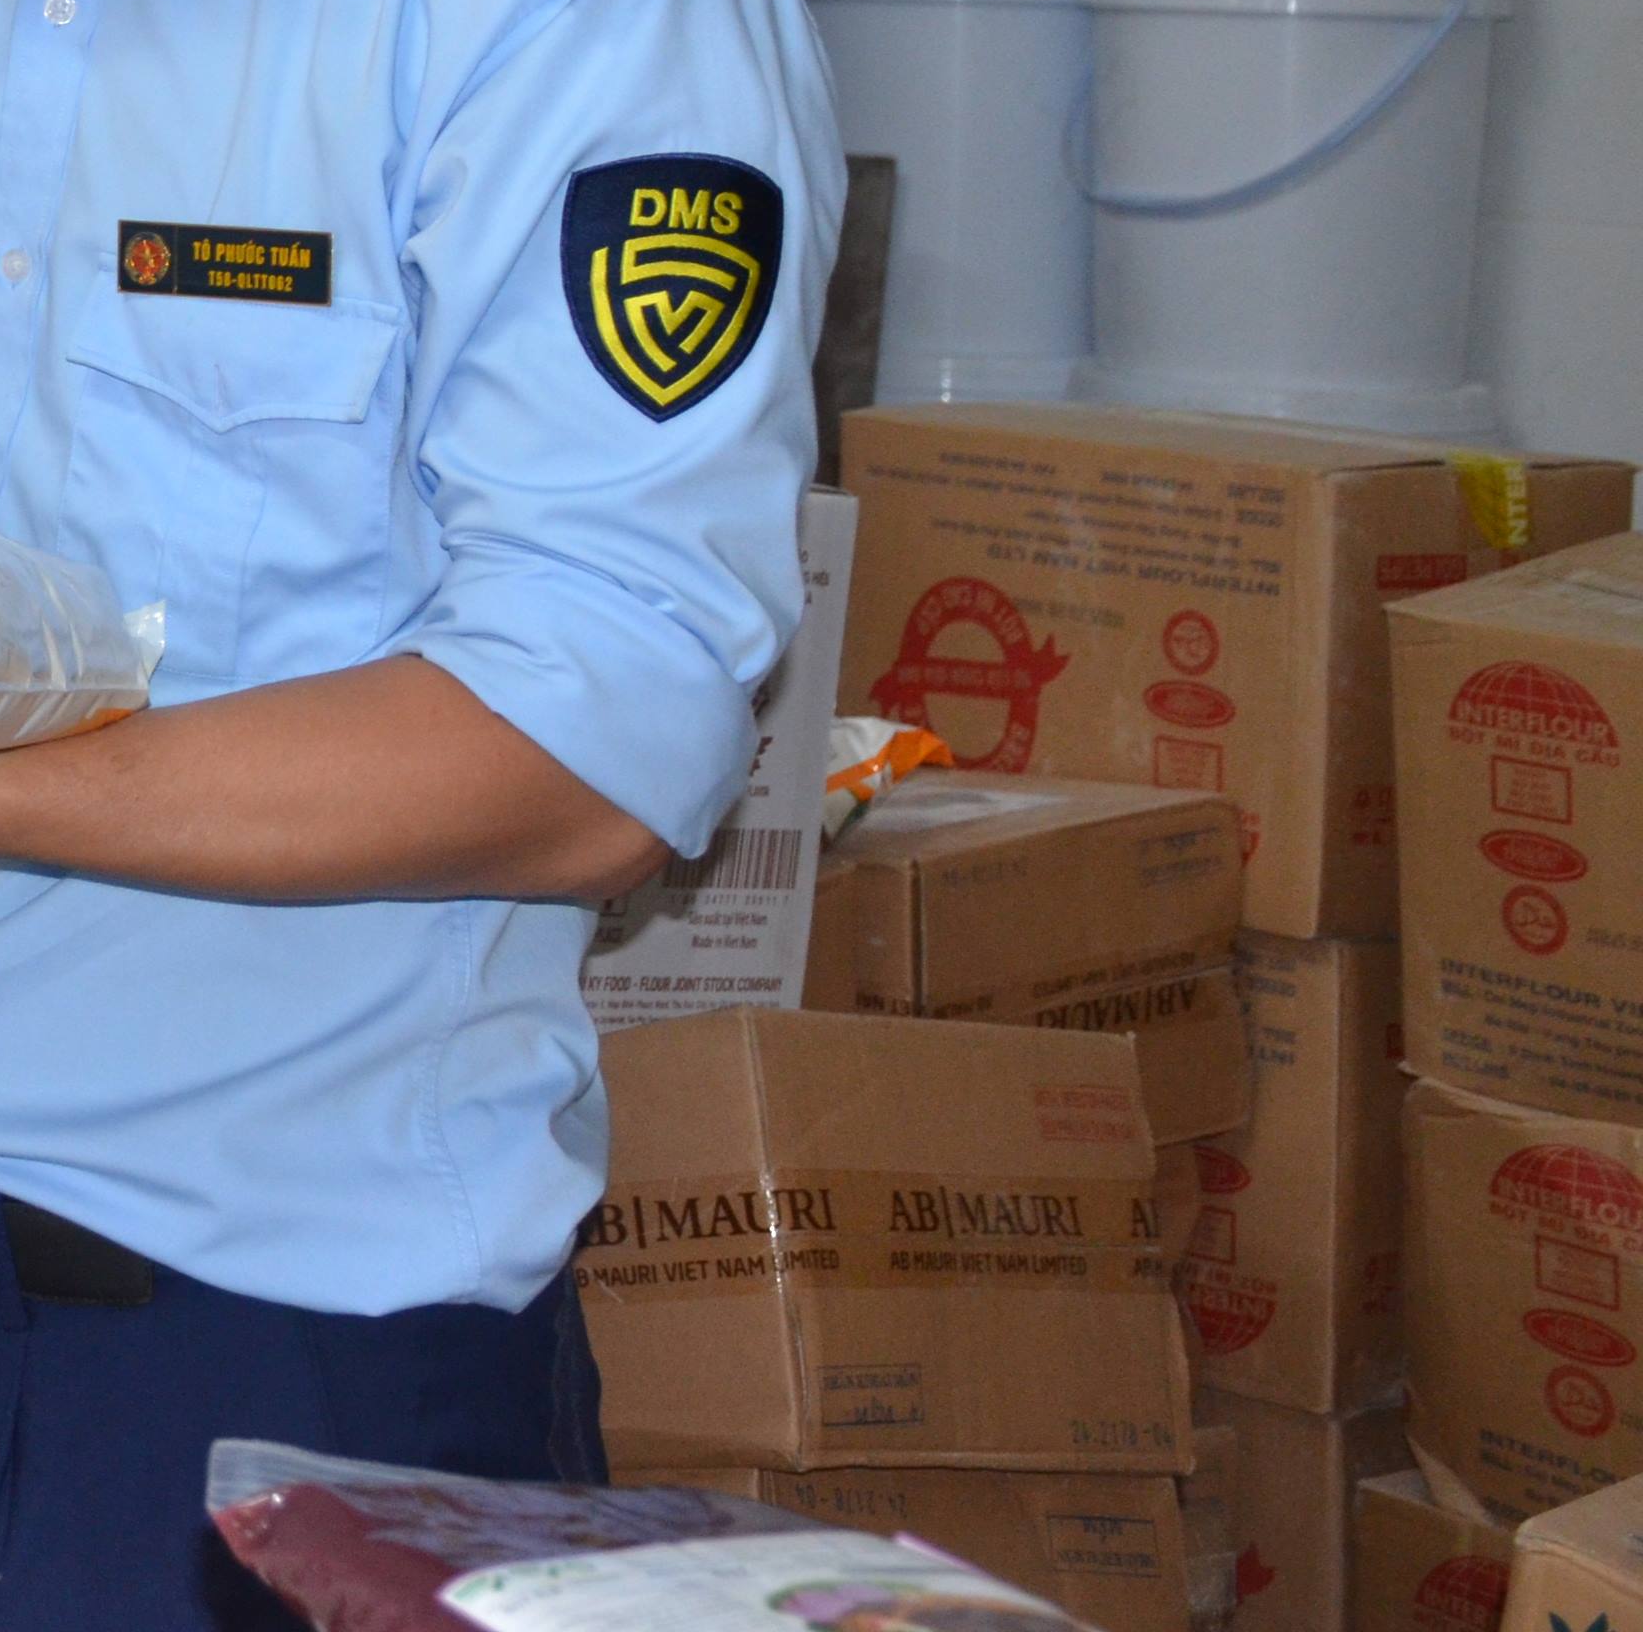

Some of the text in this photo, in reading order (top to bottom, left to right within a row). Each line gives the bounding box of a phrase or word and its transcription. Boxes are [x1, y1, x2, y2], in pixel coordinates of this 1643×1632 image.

[630, 188, 742, 235] DMS
[270, 242, 311, 269] TUẤN
[1455, 700, 1611, 746] INTERFLOUR
[603, 976, 632, 992] FOOD
[639, 976, 671, 992] FLOUR
[672, 976, 703, 992] JOINT
[703, 976, 736, 992] STOCK
[737, 976, 783, 992] COMPANY
[1441, 958, 1602, 1009] INTERFLOUR
[890, 1184, 1085, 1240] AB|MAURI
[593, 1263, 664, 1289] MAURI
[666, 1260, 709, 1284] VIET
[716, 1255, 766, 1280] NAM
[890, 1250, 910, 1270] AB
[995, 1252, 1029, 1273] NAM
[1032, 1254, 1088, 1277] LIMITED
